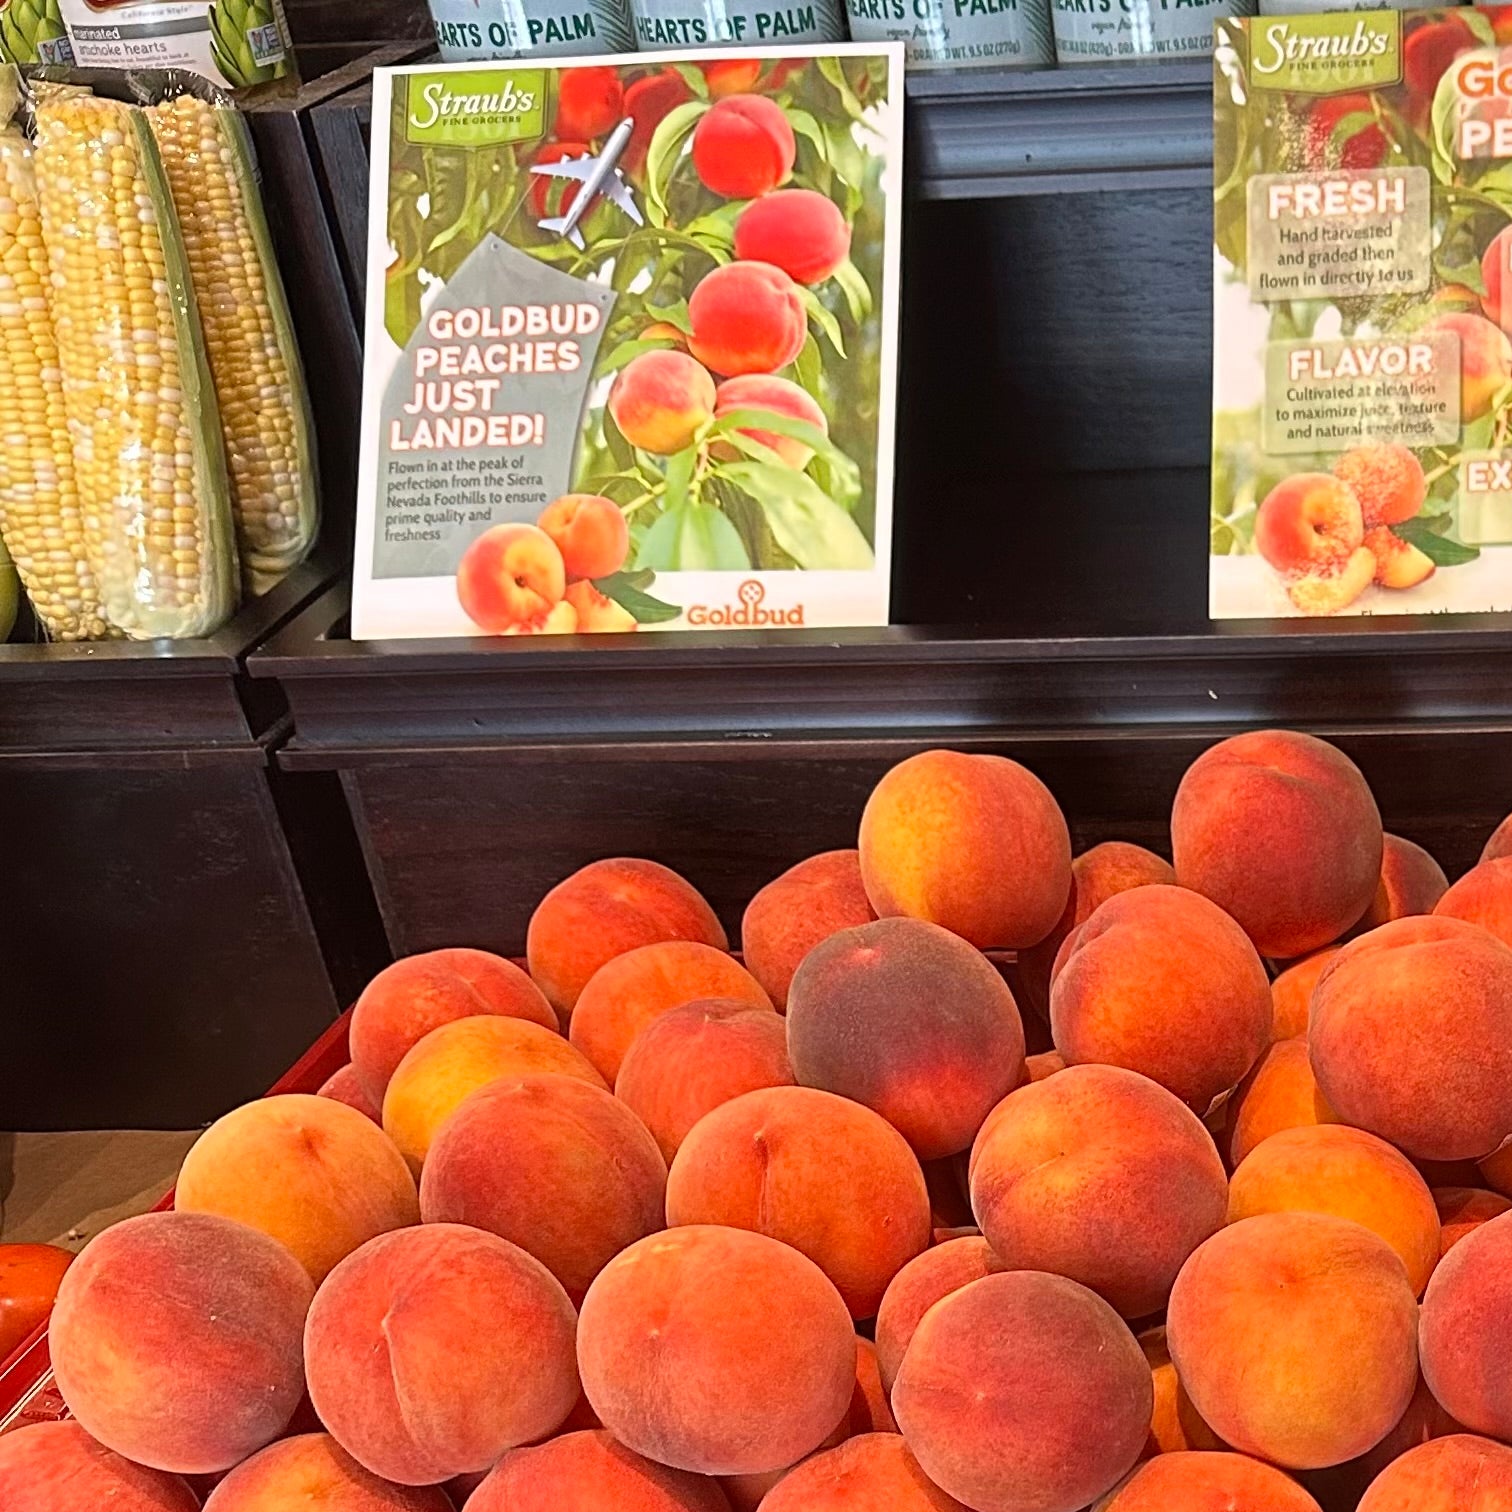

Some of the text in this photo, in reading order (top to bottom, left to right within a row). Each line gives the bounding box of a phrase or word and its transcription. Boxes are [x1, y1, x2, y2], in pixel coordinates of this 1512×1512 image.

[527, 12, 596, 44] PALM
[636, 16, 707, 44] HEARTS
[755, 5, 816, 38] PALM
[123, 41, 167, 55] hearts
[1253, 20, 1389, 73] Straub's
[410, 79, 534, 129] Straub's
[442, 115, 521, 126] FINE GROCERS
[1268, 178, 1406, 220] FRESH
[1280, 227, 1318, 243] Hand
[1277, 245, 1395, 269] and graded then
[1259, 273, 1299, 289] flown
[1303, 271, 1316, 285] in
[1378, 269, 1393, 282] to
[1397, 268, 1414, 281] us
[428, 303, 601, 340] GOLDBUD
[415, 340, 581, 378] PEACHES
[1289, 344, 1433, 381] FLAVOR
[403, 379, 500, 414] JUST
[1287, 383, 1354, 401] Cultivated
[1357, 385, 1370, 398] at
[1276, 408, 1290, 421] to
[1293, 406, 1357, 420] maximize
[391, 413, 545, 451] LANDED!
[1287, 424, 1312, 439] and
[1316, 423, 1362, 437] natural
[389, 455, 525, 475] Flown in at the peak of
[387, 472, 543, 494] perfection from the Sierra
[387, 491, 547, 508] Nevada Foothills to ensure
[385, 507, 492, 528] prime quality and
[385, 528, 441, 542] freshness
[687, 598, 805, 625] Goldbud
